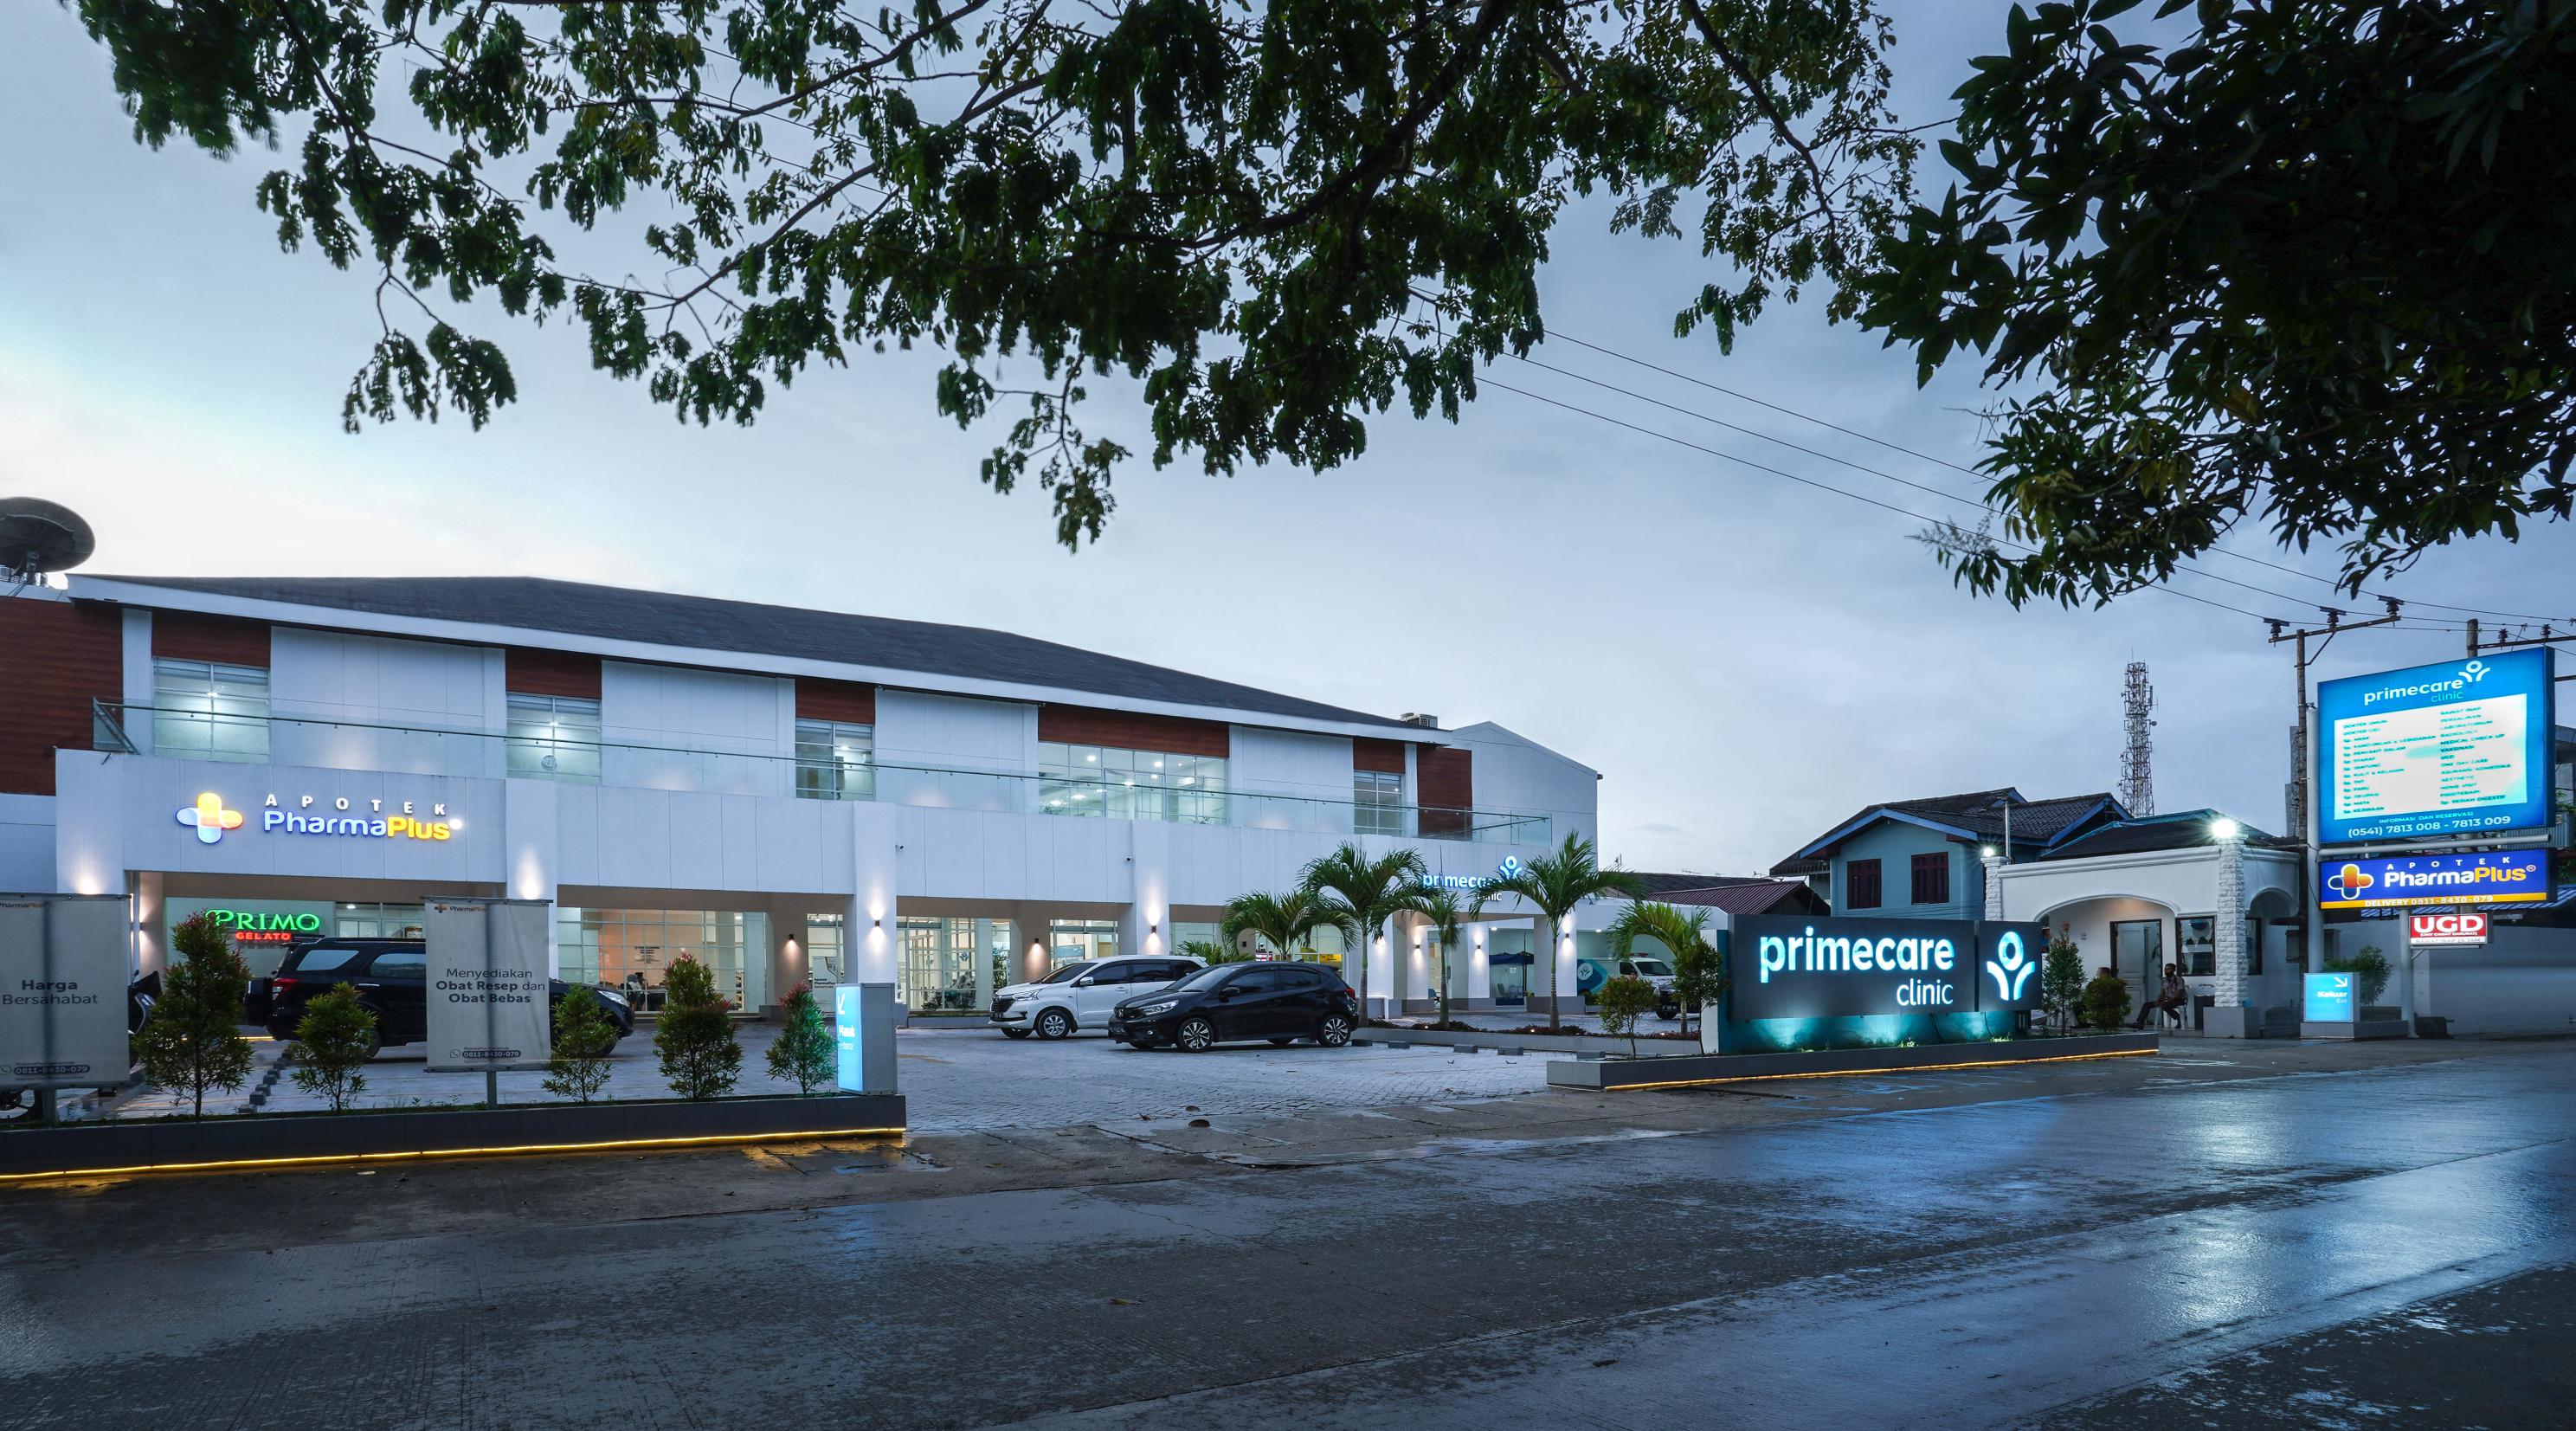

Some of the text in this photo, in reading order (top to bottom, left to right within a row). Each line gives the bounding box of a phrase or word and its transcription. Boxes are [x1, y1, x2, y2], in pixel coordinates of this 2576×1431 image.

[2364, 678, 2463, 706] primecare
[2431, 691, 2464, 703] clinic
[265, 793, 446, 815] APOTEK
[2435, 811, 2474, 820] RESERVASI
[263, 809, 451, 841] PharmaPlus
[2347, 826, 2383, 839] (0541)
[2386, 824, 2412, 834] 7813
[2416, 822, 2440, 831] 008
[2451, 818, 2481, 828] 7813
[2483, 815, 2511, 826] 009
[2386, 856, 2510, 870] APOTEK
[2365, 894, 2494, 907] DELIVERY 0811-8430-079
[205, 909, 320, 931] PRIMO
[2414, 915, 2483, 933] UGD
[235, 931, 292, 941] GELATO
[1760, 925, 1954, 983] primecare
[447, 969, 532, 979] Menyediakan
[22, 980, 78, 993] Harga
[436, 981, 545, 992] Obat Resep dan
[1897, 978, 1953, 1006] clinic
[3, 994, 99, 1005] Bersahabat
[448, 993, 531, 1003] Obat Bebas
[16, 1066, 87, 1074] 0811-830-079
